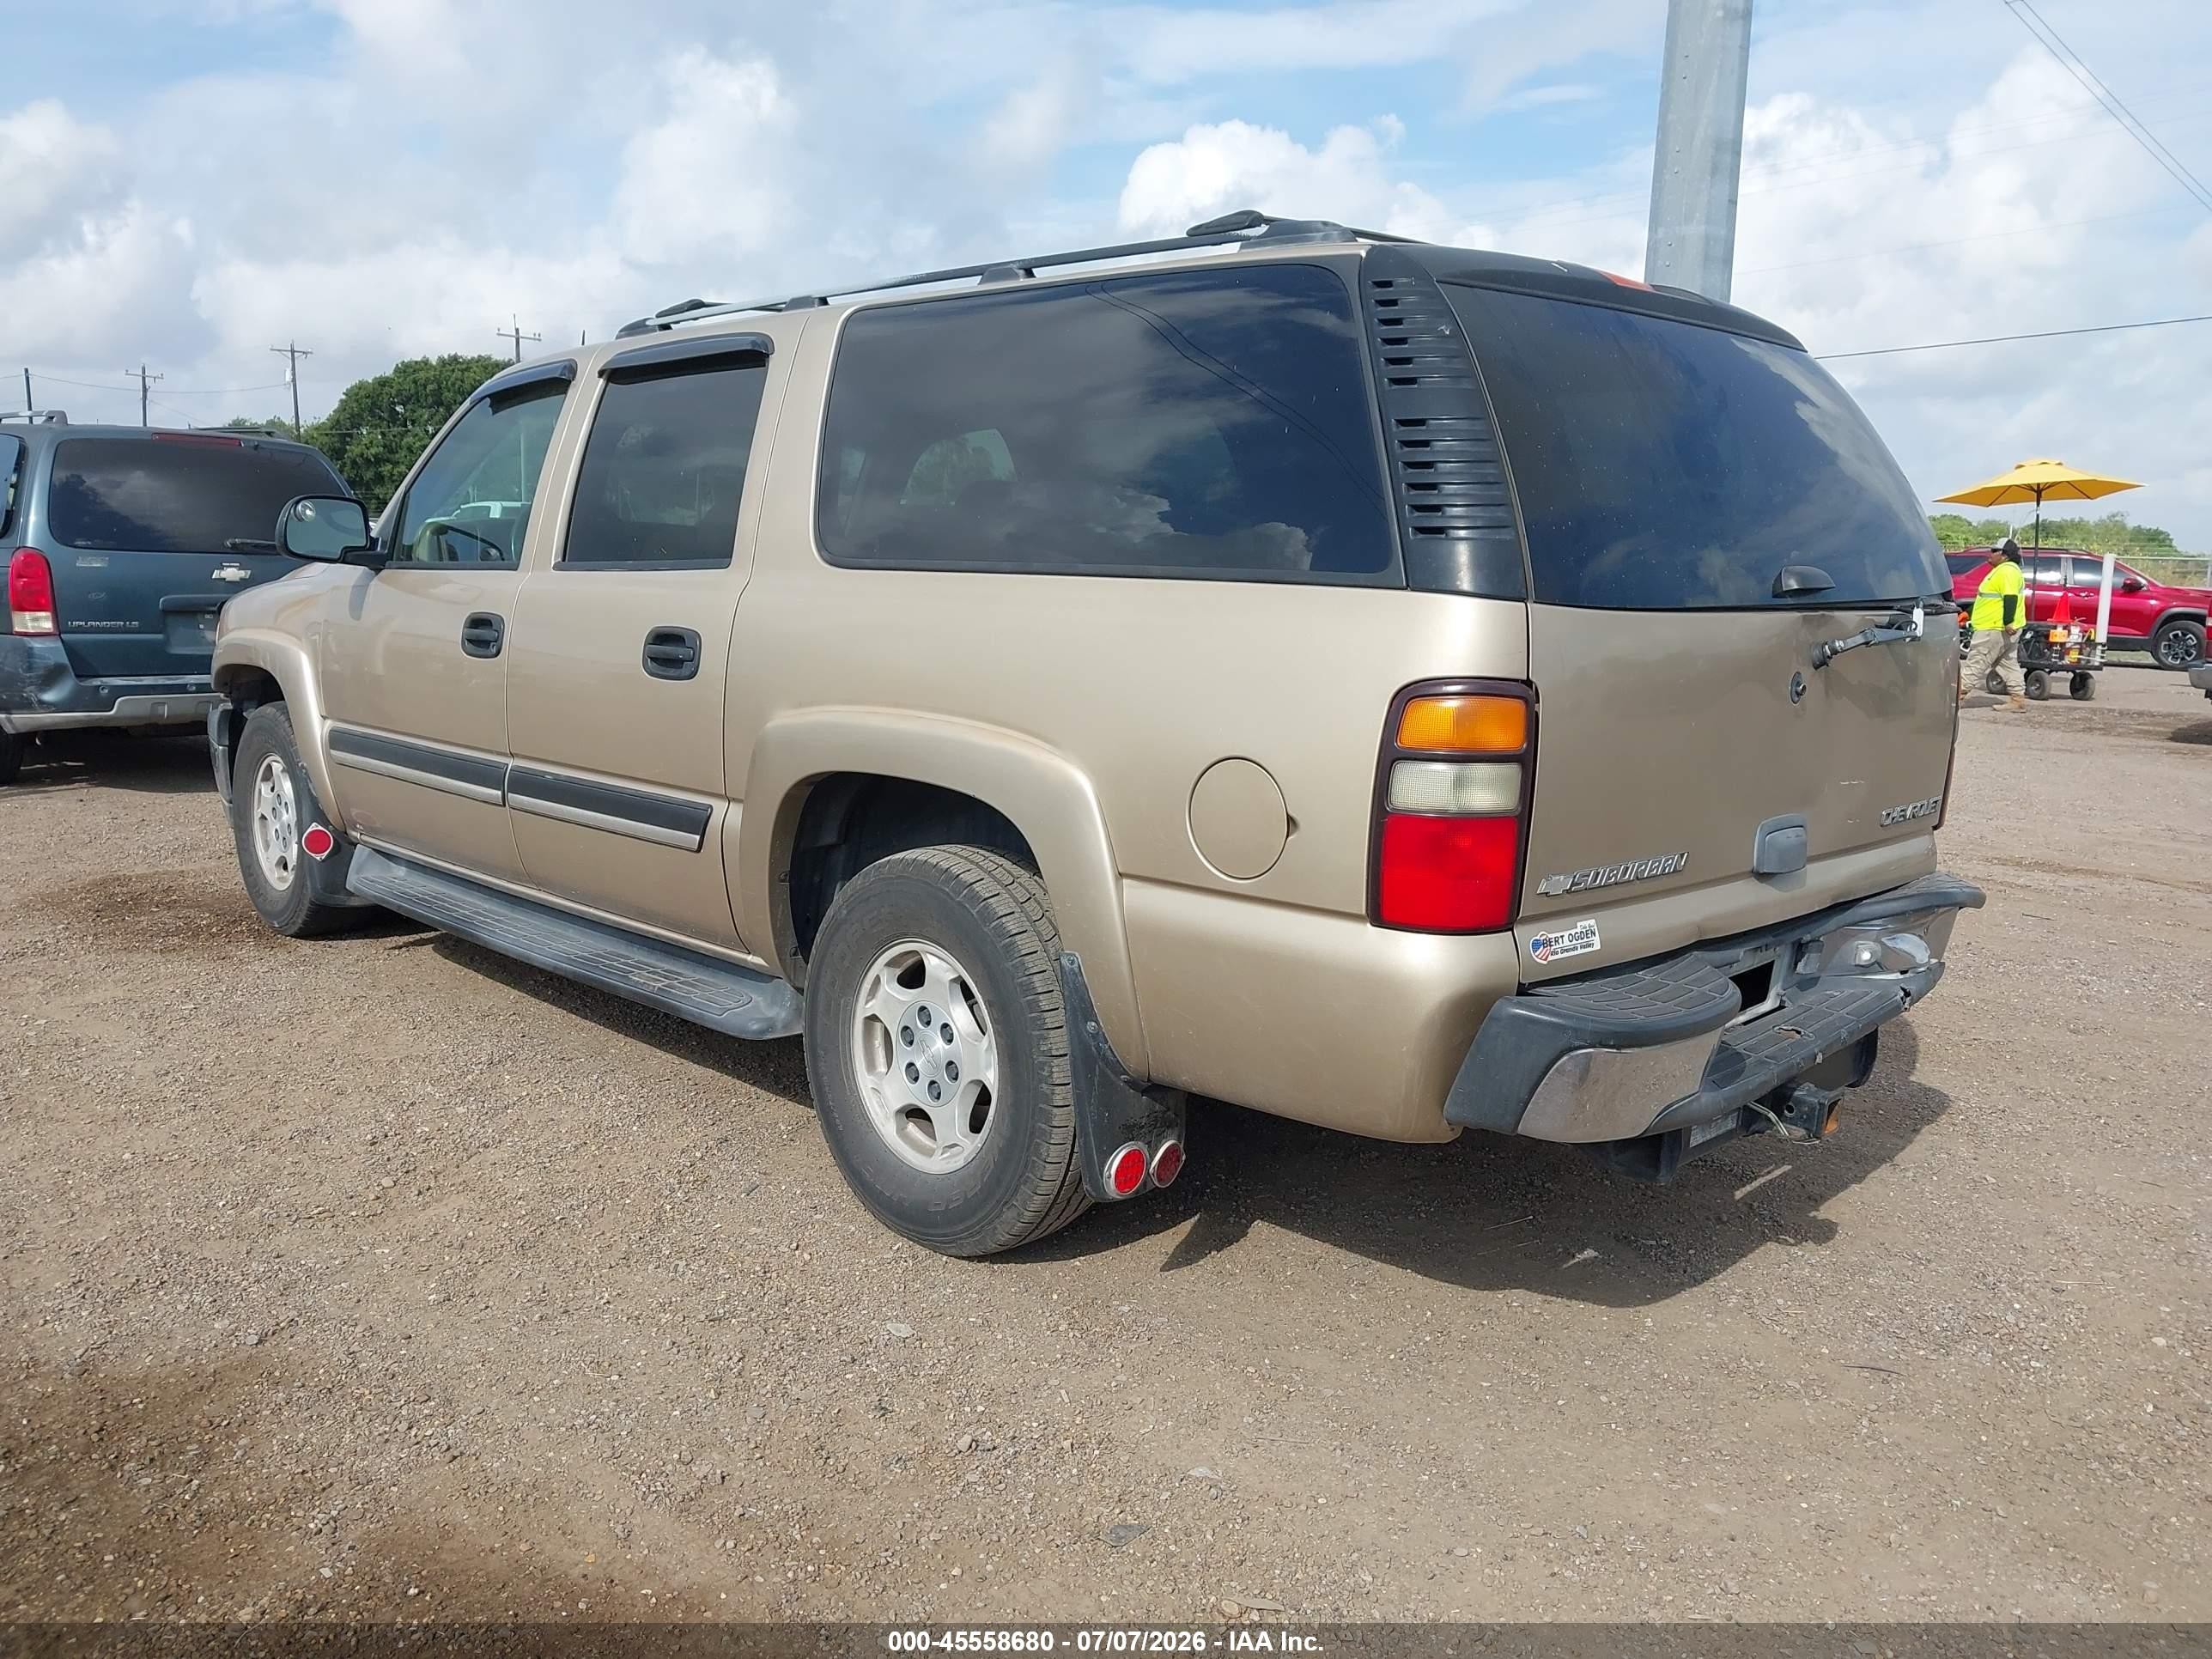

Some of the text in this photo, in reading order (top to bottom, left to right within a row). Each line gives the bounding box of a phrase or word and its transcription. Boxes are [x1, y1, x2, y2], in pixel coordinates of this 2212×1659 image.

[1571, 852, 1689, 893] SUBURBAN
[1542, 928, 1596, 949] BERT OGDEN
[1559, 945, 1579, 955] Grande
